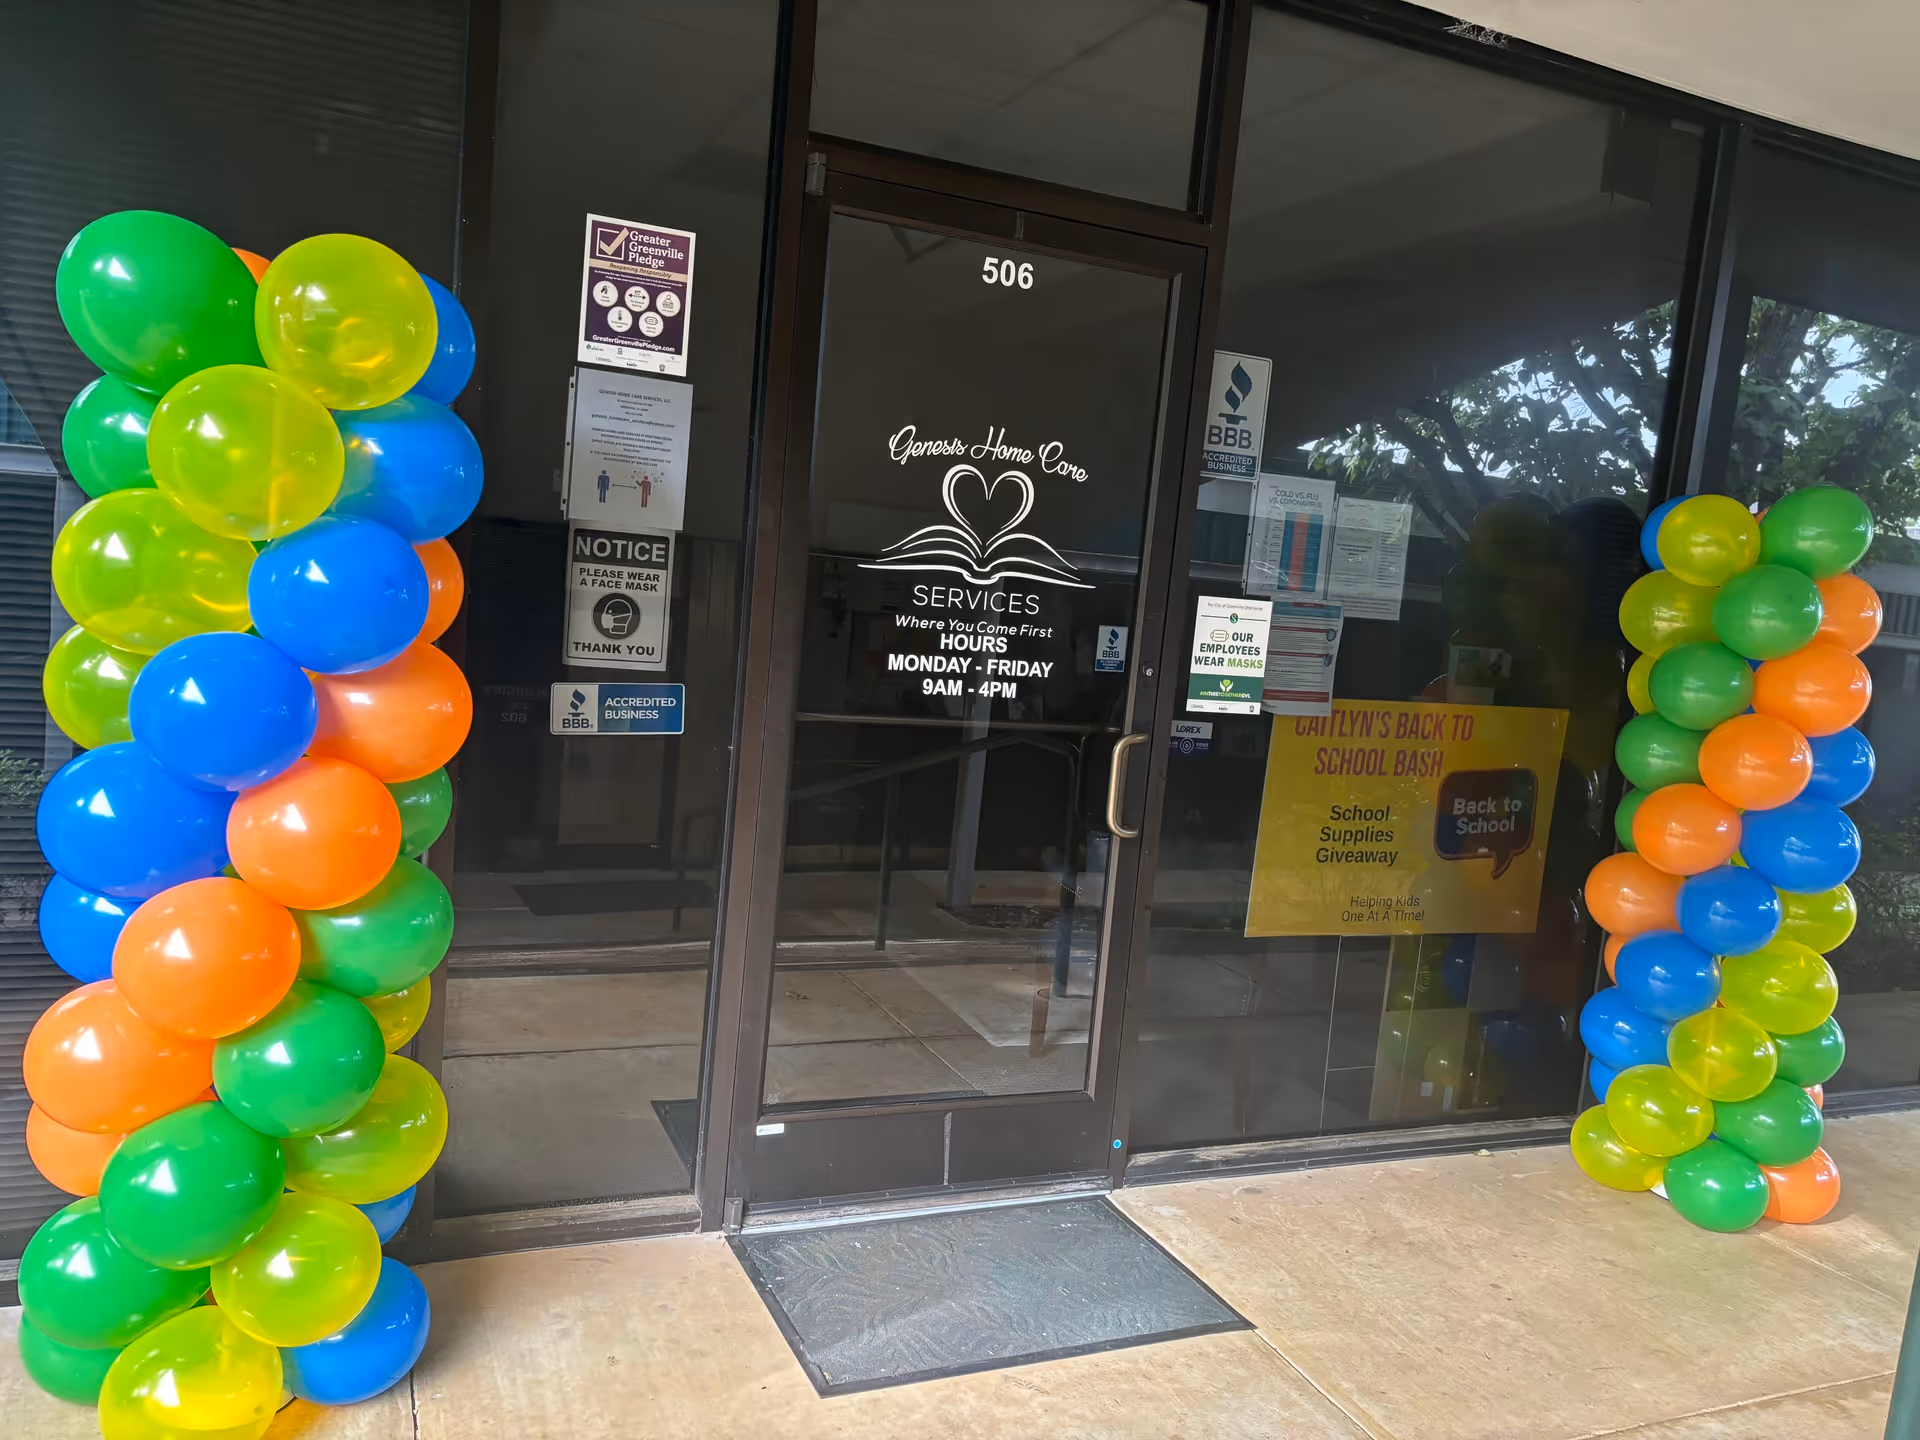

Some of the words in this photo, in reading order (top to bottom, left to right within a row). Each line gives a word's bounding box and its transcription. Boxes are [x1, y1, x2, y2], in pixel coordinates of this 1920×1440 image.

[630, 231, 671, 247] Greater
[629, 241, 684, 260] Greenville
[628, 252, 664, 268] Pledge
[609, 263, 638, 273] Reopening
[639, 268, 672, 279] Responsibly
[981, 256, 1034, 290] 506
[592, 334, 675, 352] GreaterGreenvillePledge.com
[1207, 424, 1252, 449] BBB
[888, 424, 969, 465] Genesis
[969, 425, 1035, 465] Home
[1038, 440, 1089, 482] Care
[1202, 452, 1253, 465] ACCREDITED
[1207, 461, 1246, 473] BUSINESS
[1275, 489, 1294, 498] COLD
[1295, 491, 1306, 499] VS.
[1306, 493, 1319, 501] FLU
[1279, 497, 1323, 508] CORONAVIRUS
[575, 536, 666, 563] NOTICE
[579, 567, 624, 580] PLEASE
[627, 571, 660, 582] WEAR
[579, 577, 588, 586] A
[591, 579, 622, 589] FACE
[625, 581, 658, 592] MASK
[912, 584, 1040, 615] SERVICES
[895, 614, 946, 632] Where
[948, 618, 975, 633] You
[975, 621, 1018, 636] Come
[1019, 623, 1053, 639] First
[940, 633, 1008, 654] HOURS
[1231, 632, 1254, 643] OUR
[573, 641, 622, 654] THANK
[626, 645, 655, 656] YOU
[1102, 650, 1120, 659] BBB
[1199, 643, 1261, 656] EMPLOYEES
[887, 653, 973, 675] MONDAY
[986, 658, 1053, 679] FRIDAY
[1194, 655, 1225, 667] WEAR
[1227, 657, 1264, 669] MASKS
[921, 678, 964, 697] 9AM
[978, 681, 1017, 699] 4PM
[604, 697, 676, 707] ACCREDITED
[604, 710, 659, 719] BUSINESS
[562, 718, 591, 729] BBB
[1176, 724, 1202, 734] LOREX
[1295, 710, 1390, 740] CAITLYN'S
[1395, 712, 1447, 741] BACK
[1452, 714, 1474, 742] TO
[1314, 747, 1387, 777] SCHOOL
[1393, 750, 1446, 778] BASH
[1329, 805, 1390, 822] School
[1452, 797, 1497, 816] Back
[1503, 796, 1522, 813] to
[1455, 816, 1516, 835] School
[1319, 826, 1394, 846] Supplies
[1315, 847, 1399, 867] Giveaway
[1350, 895, 1393, 910] Helping
[1395, 894, 1420, 907] Kids
[1341, 910, 1364, 922] One
[1366, 910, 1379, 922] At
[1381, 910, 1391, 922] A
